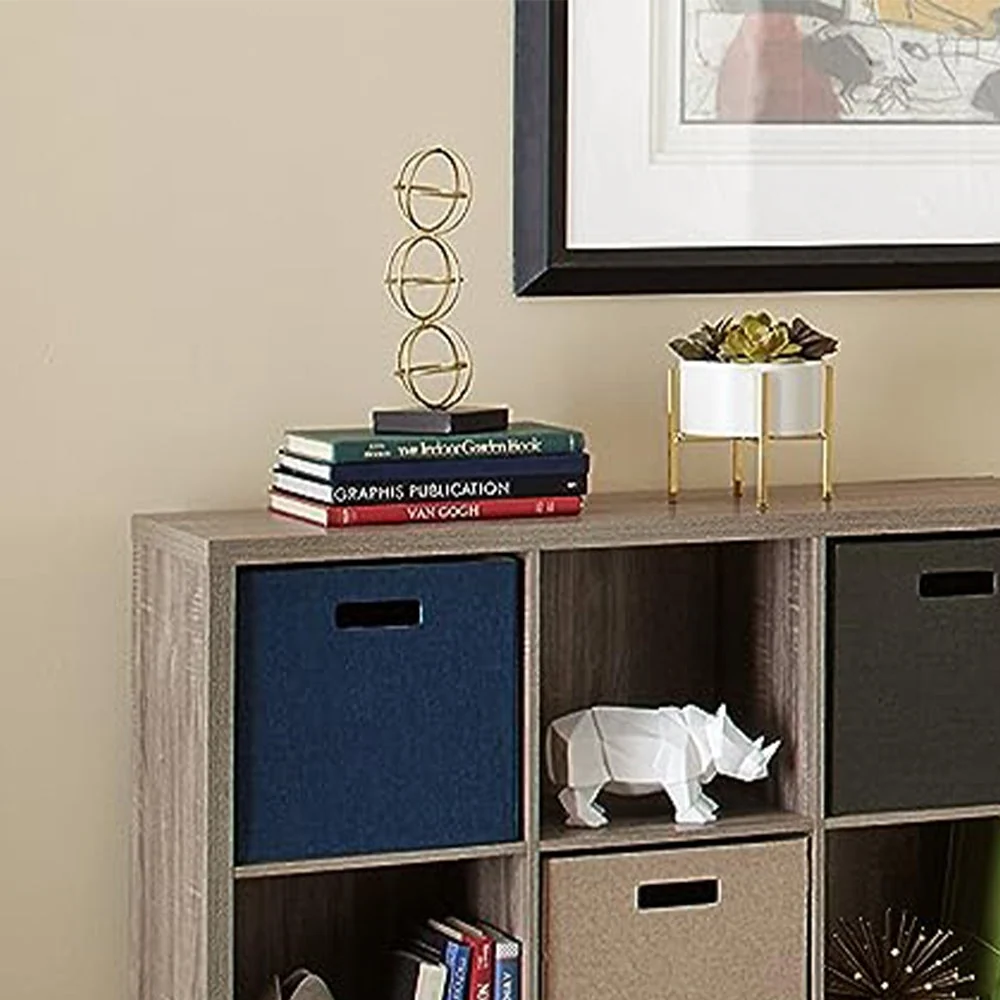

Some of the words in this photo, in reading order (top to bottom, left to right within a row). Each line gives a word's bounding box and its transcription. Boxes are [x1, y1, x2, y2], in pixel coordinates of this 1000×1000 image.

[333, 483, 404, 502] GRAPHIS
[409, 480, 511, 499] PUBLICATION
[406, 505, 437, 520] VAN
[437, 503, 481, 519] GOGH
